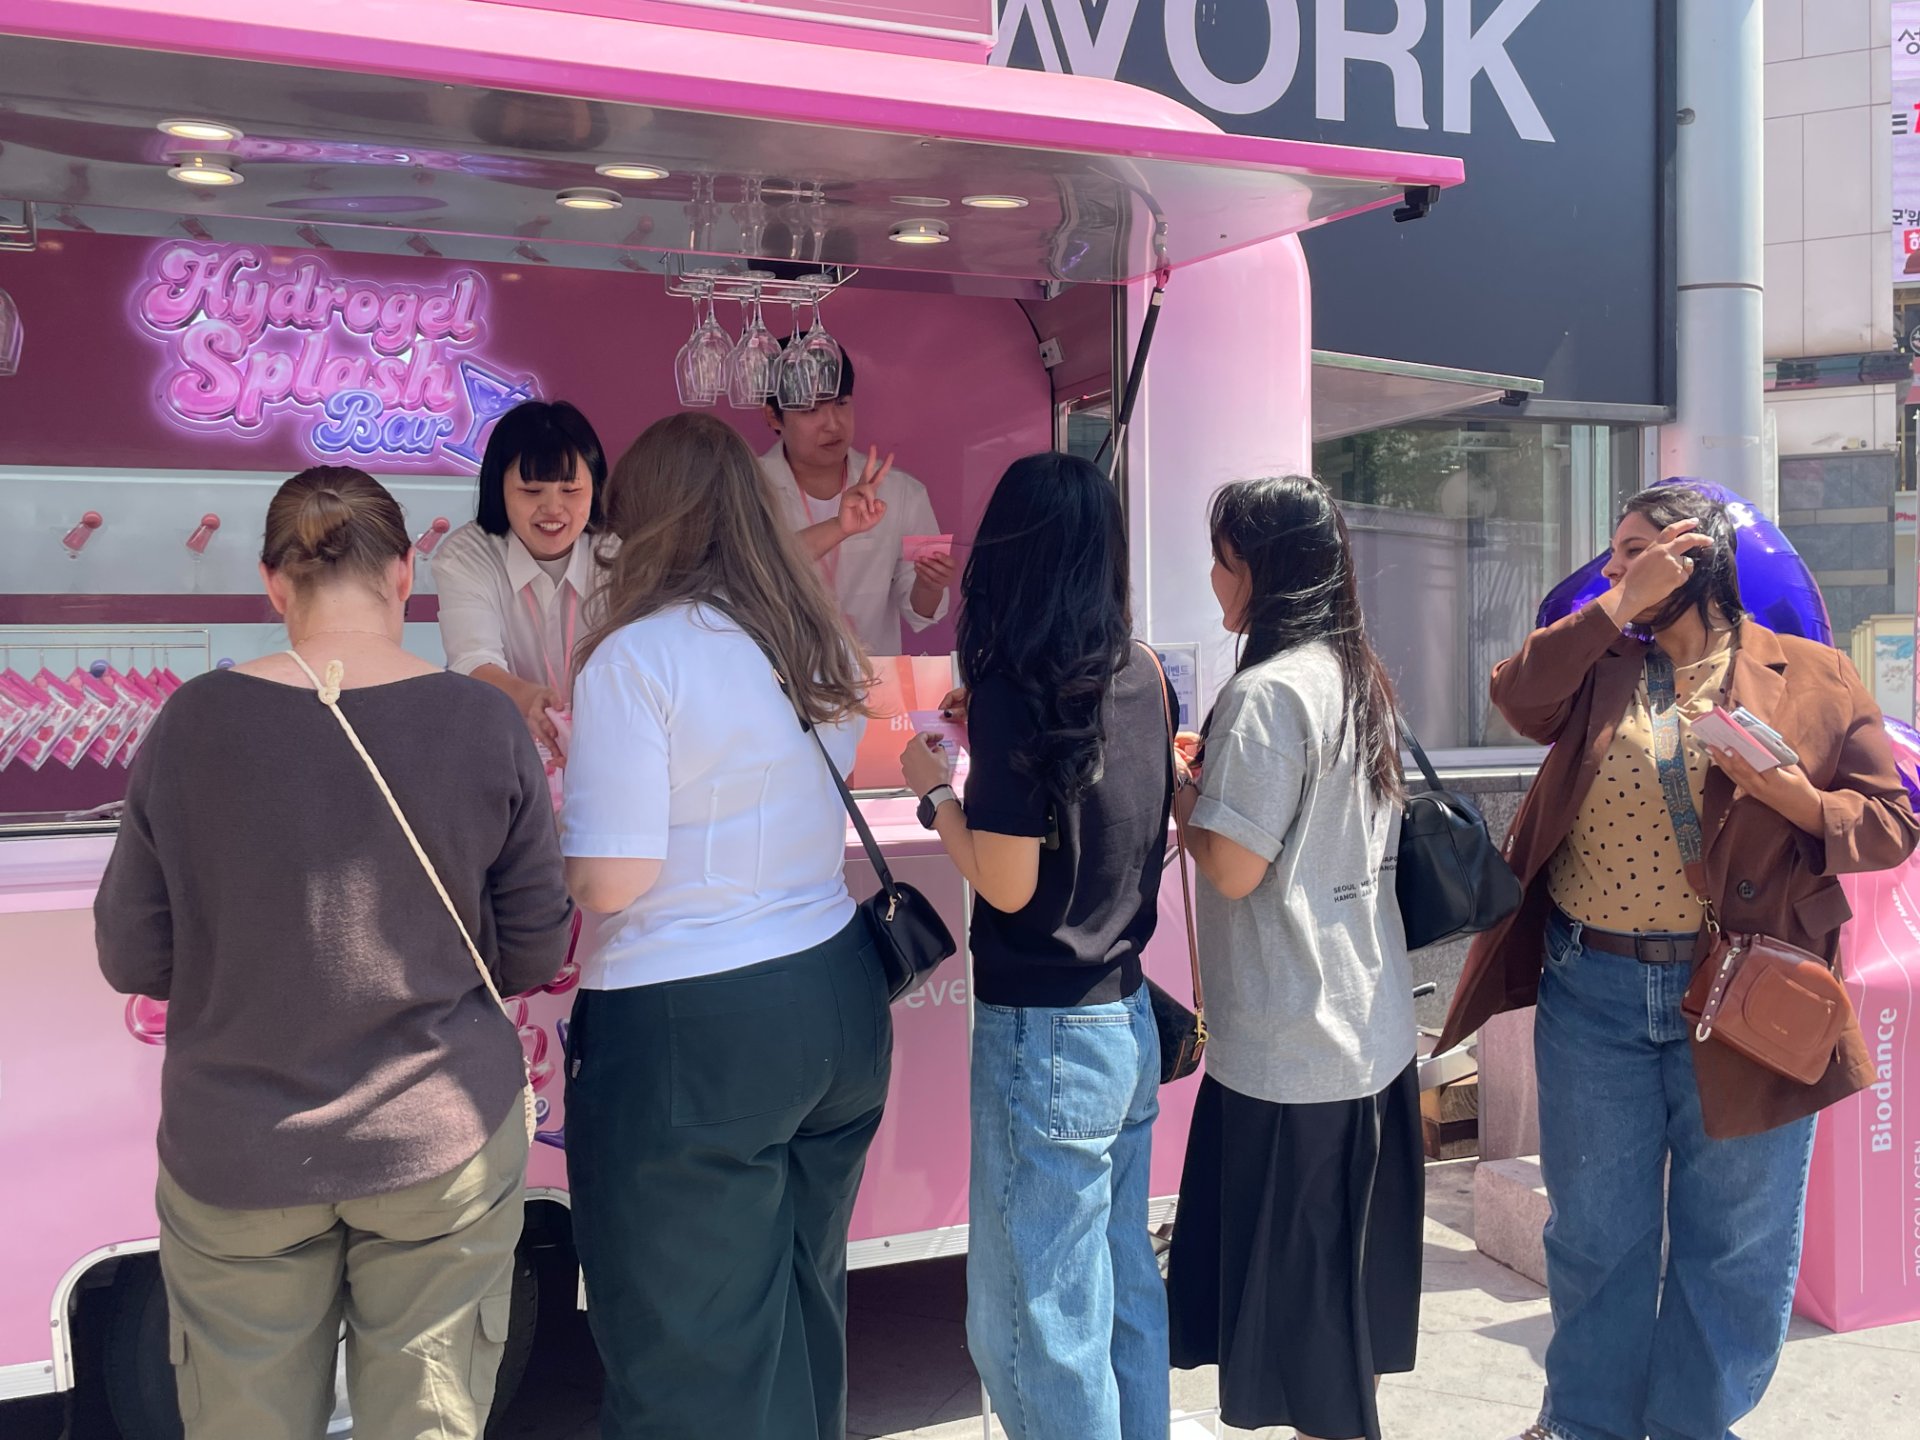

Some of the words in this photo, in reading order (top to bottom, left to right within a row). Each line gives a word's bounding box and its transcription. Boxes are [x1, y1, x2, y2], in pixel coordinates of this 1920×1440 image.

[141, 245, 480, 355] Hydrogel
[169, 319, 458, 428] Splash
[310, 388, 454, 455] Bar
[1333, 883, 1357, 894] SEOUL
[1333, 892, 1358, 904] HANOI
[1869, 1007, 1898, 1153] Biodance
